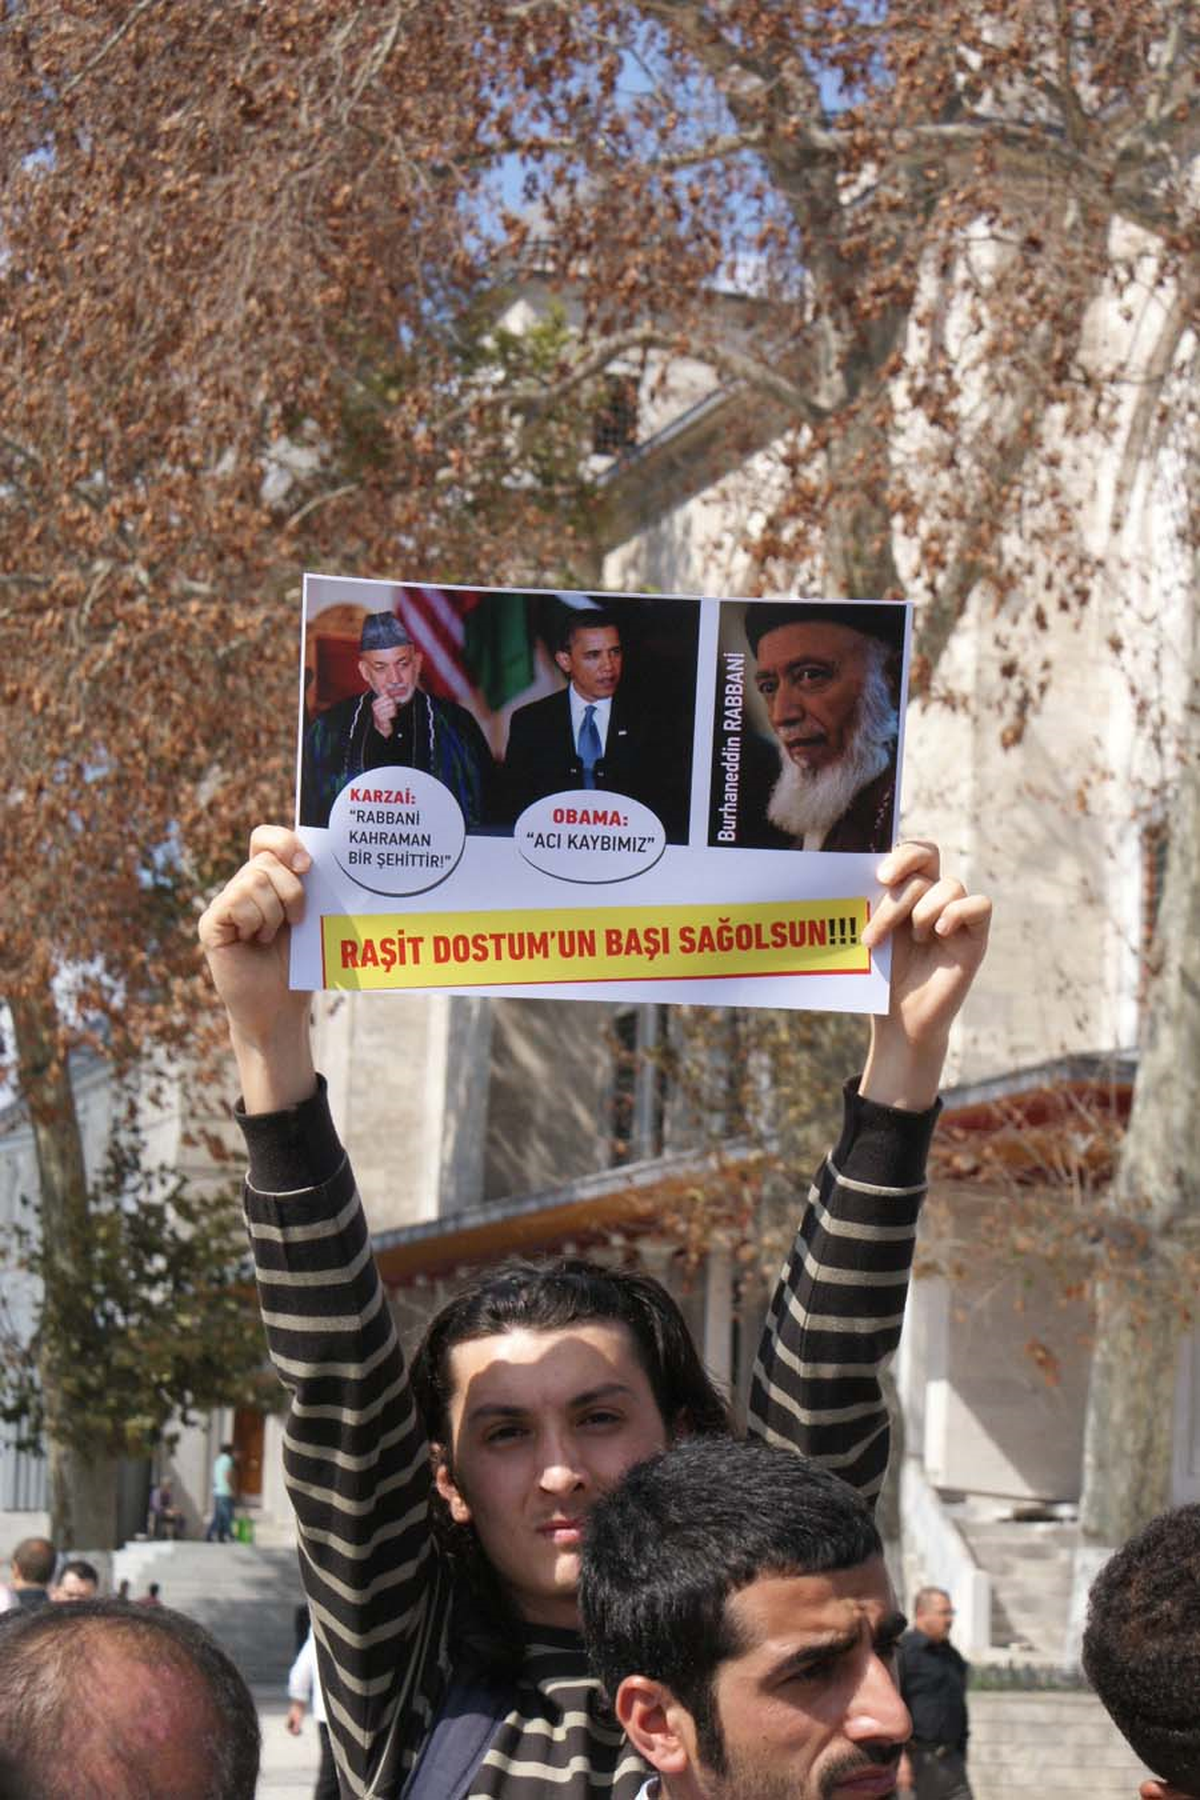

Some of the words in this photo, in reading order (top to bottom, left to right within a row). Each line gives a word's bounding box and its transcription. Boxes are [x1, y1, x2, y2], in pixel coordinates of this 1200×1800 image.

[723, 652, 745, 731] RABBANİ
[350, 788, 416, 805] KARZAİ:
[717, 736, 741, 842] Burhaneddin
[552, 808, 629, 827] OBAMA:
[349, 830, 431, 847] KAHRAMAN
[526, 833, 561, 850] “ACI
[567, 833, 655, 853] KAYBIMIZ”
[348, 849, 373, 865] BİR
[340, 929, 425, 974] RAŞİT
[606, 927, 670, 960] BAŞI
[679, 917, 857, 953] SAĞOLSUN!!!
